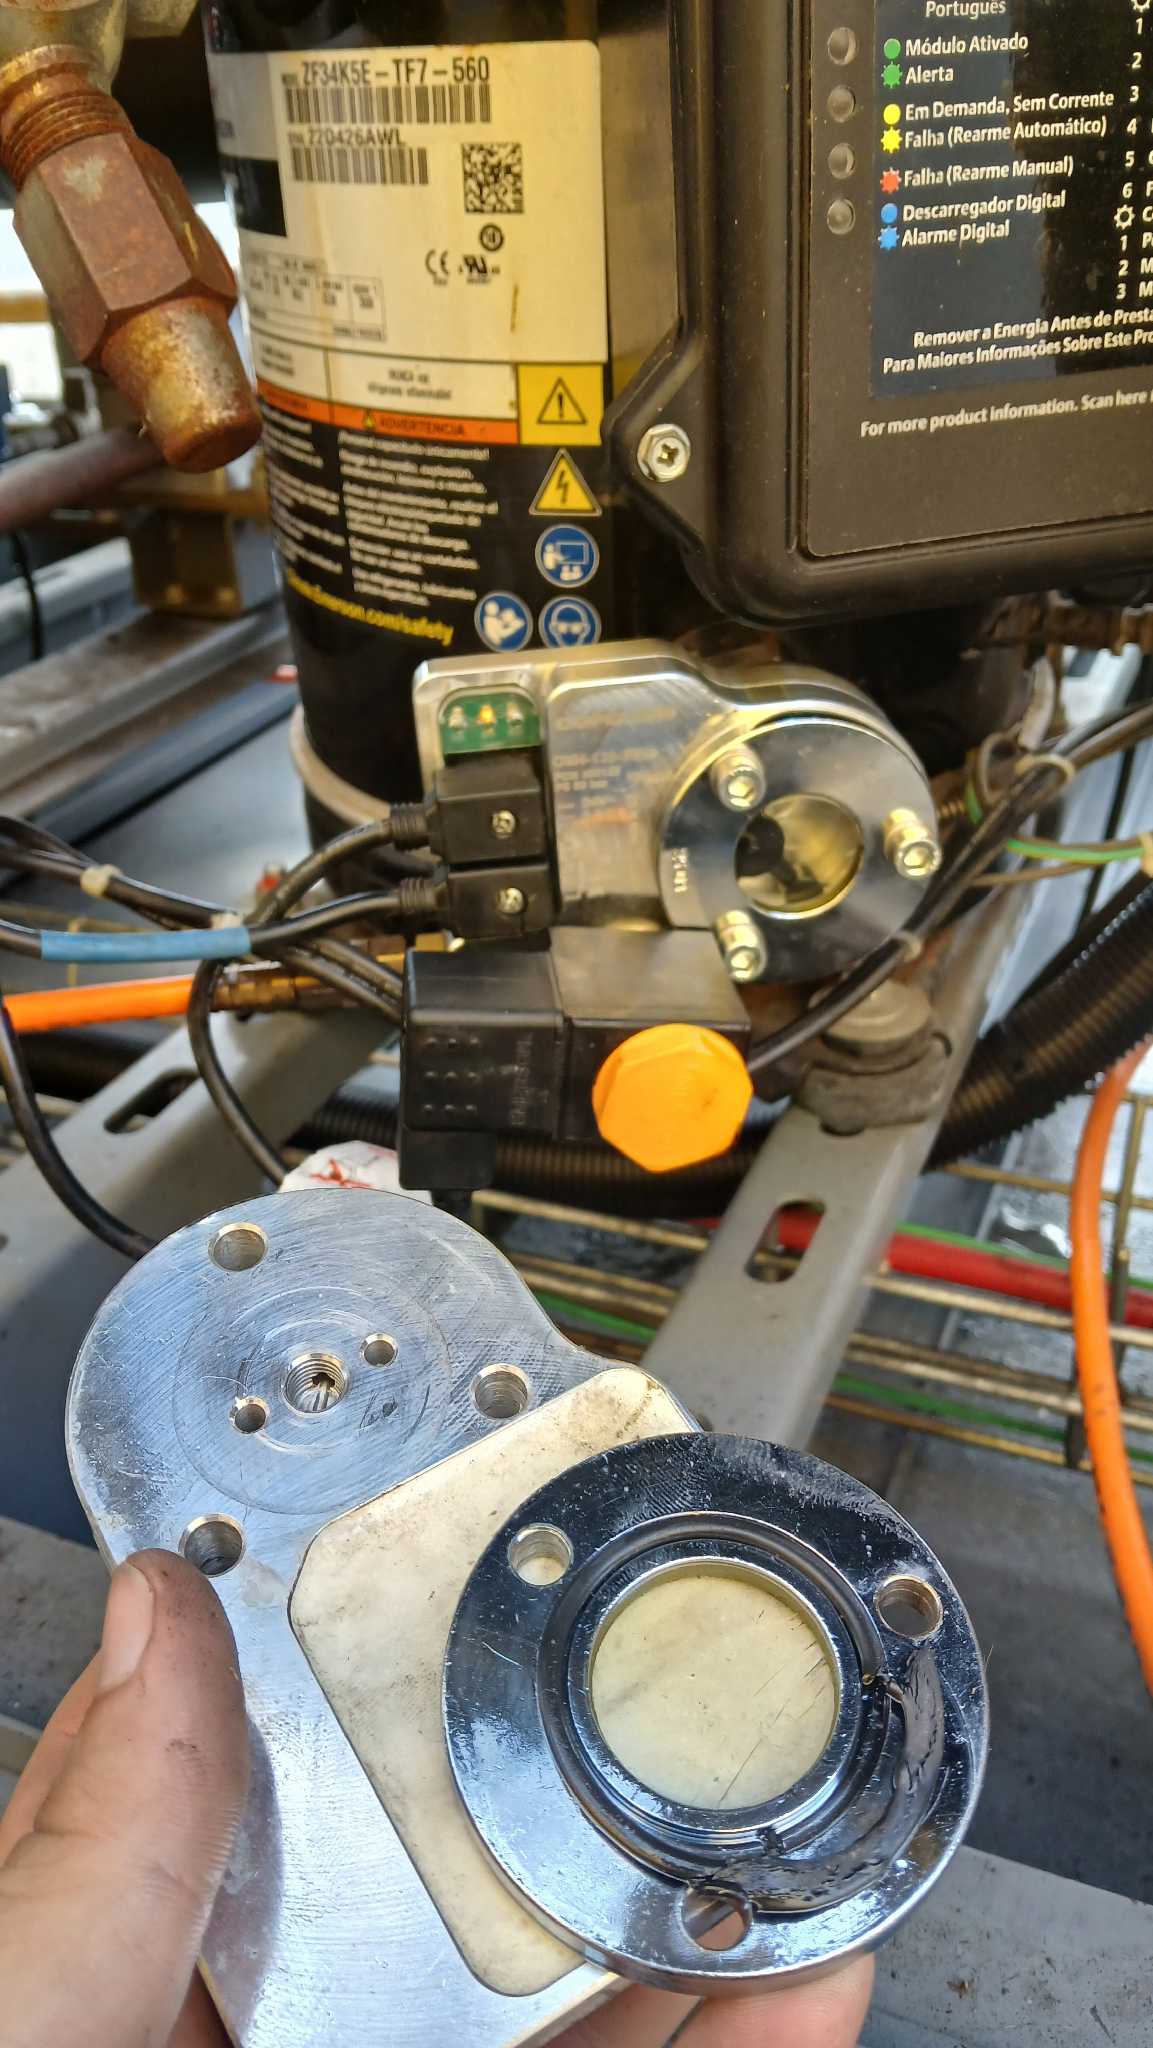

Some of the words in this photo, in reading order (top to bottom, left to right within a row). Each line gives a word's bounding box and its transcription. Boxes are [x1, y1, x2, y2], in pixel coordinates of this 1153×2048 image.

[925, 0, 1006, 20] Português
[1135, 17, 1143, 35] 1
[905, 35, 967, 57] Módulo
[969, 31, 1029, 53] Ativado
[1131, 51, 1143, 69] 2
[905, 65, 954, 85] Alerta
[1129, 85, 1140, 102] 3
[905, 104, 929, 121] Em
[932, 96, 1010, 115] Demanda,
[1013, 95, 1046, 113] Sem
[1048, 91, 1114, 110] Corrente
[905, 130, 944, 149] Falha
[948, 126, 1011, 148] (Rearme
[1013, 115, 1107, 139] Automático)
[1126, 118, 1138, 135] 4
[1125, 150, 1135, 168] 5
[904, 168, 943, 187] Falha
[946, 165, 1009, 186] (Rearme
[1012, 156, 1074, 178] Manual)
[1122, 182, 1133, 198] 6
[903, 196, 1014, 222] Descarregador
[1015, 190, 1066, 213] Digital
[902, 228, 957, 247] Alarme
[960, 219, 1010, 243] Digital
[1120, 234, 1128, 251] 1
[1118, 259, 1129, 276] 2
[1116, 283, 1126, 299] 3
[913, 328, 980, 348] Remover
[982, 327, 991, 340] a
[993, 318, 1049, 340] Energia
[1050, 315, 1092, 333] Antes
[1094, 310, 1112, 328] de
[883, 357, 915, 374] Para
[918, 351, 975, 370] Maiores
[976, 339, 1061, 363] Informações
[1063, 334, 1102, 353] Sobre
[1104, 331, 1132, 348] Este
[860, 420, 886, 438] For
[887, 417, 928, 433] more
[929, 407, 988, 432] product
[990, 399, 1078, 422] information.
[1080, 394, 1114, 412] Scan
[1115, 389, 1148, 407] here
